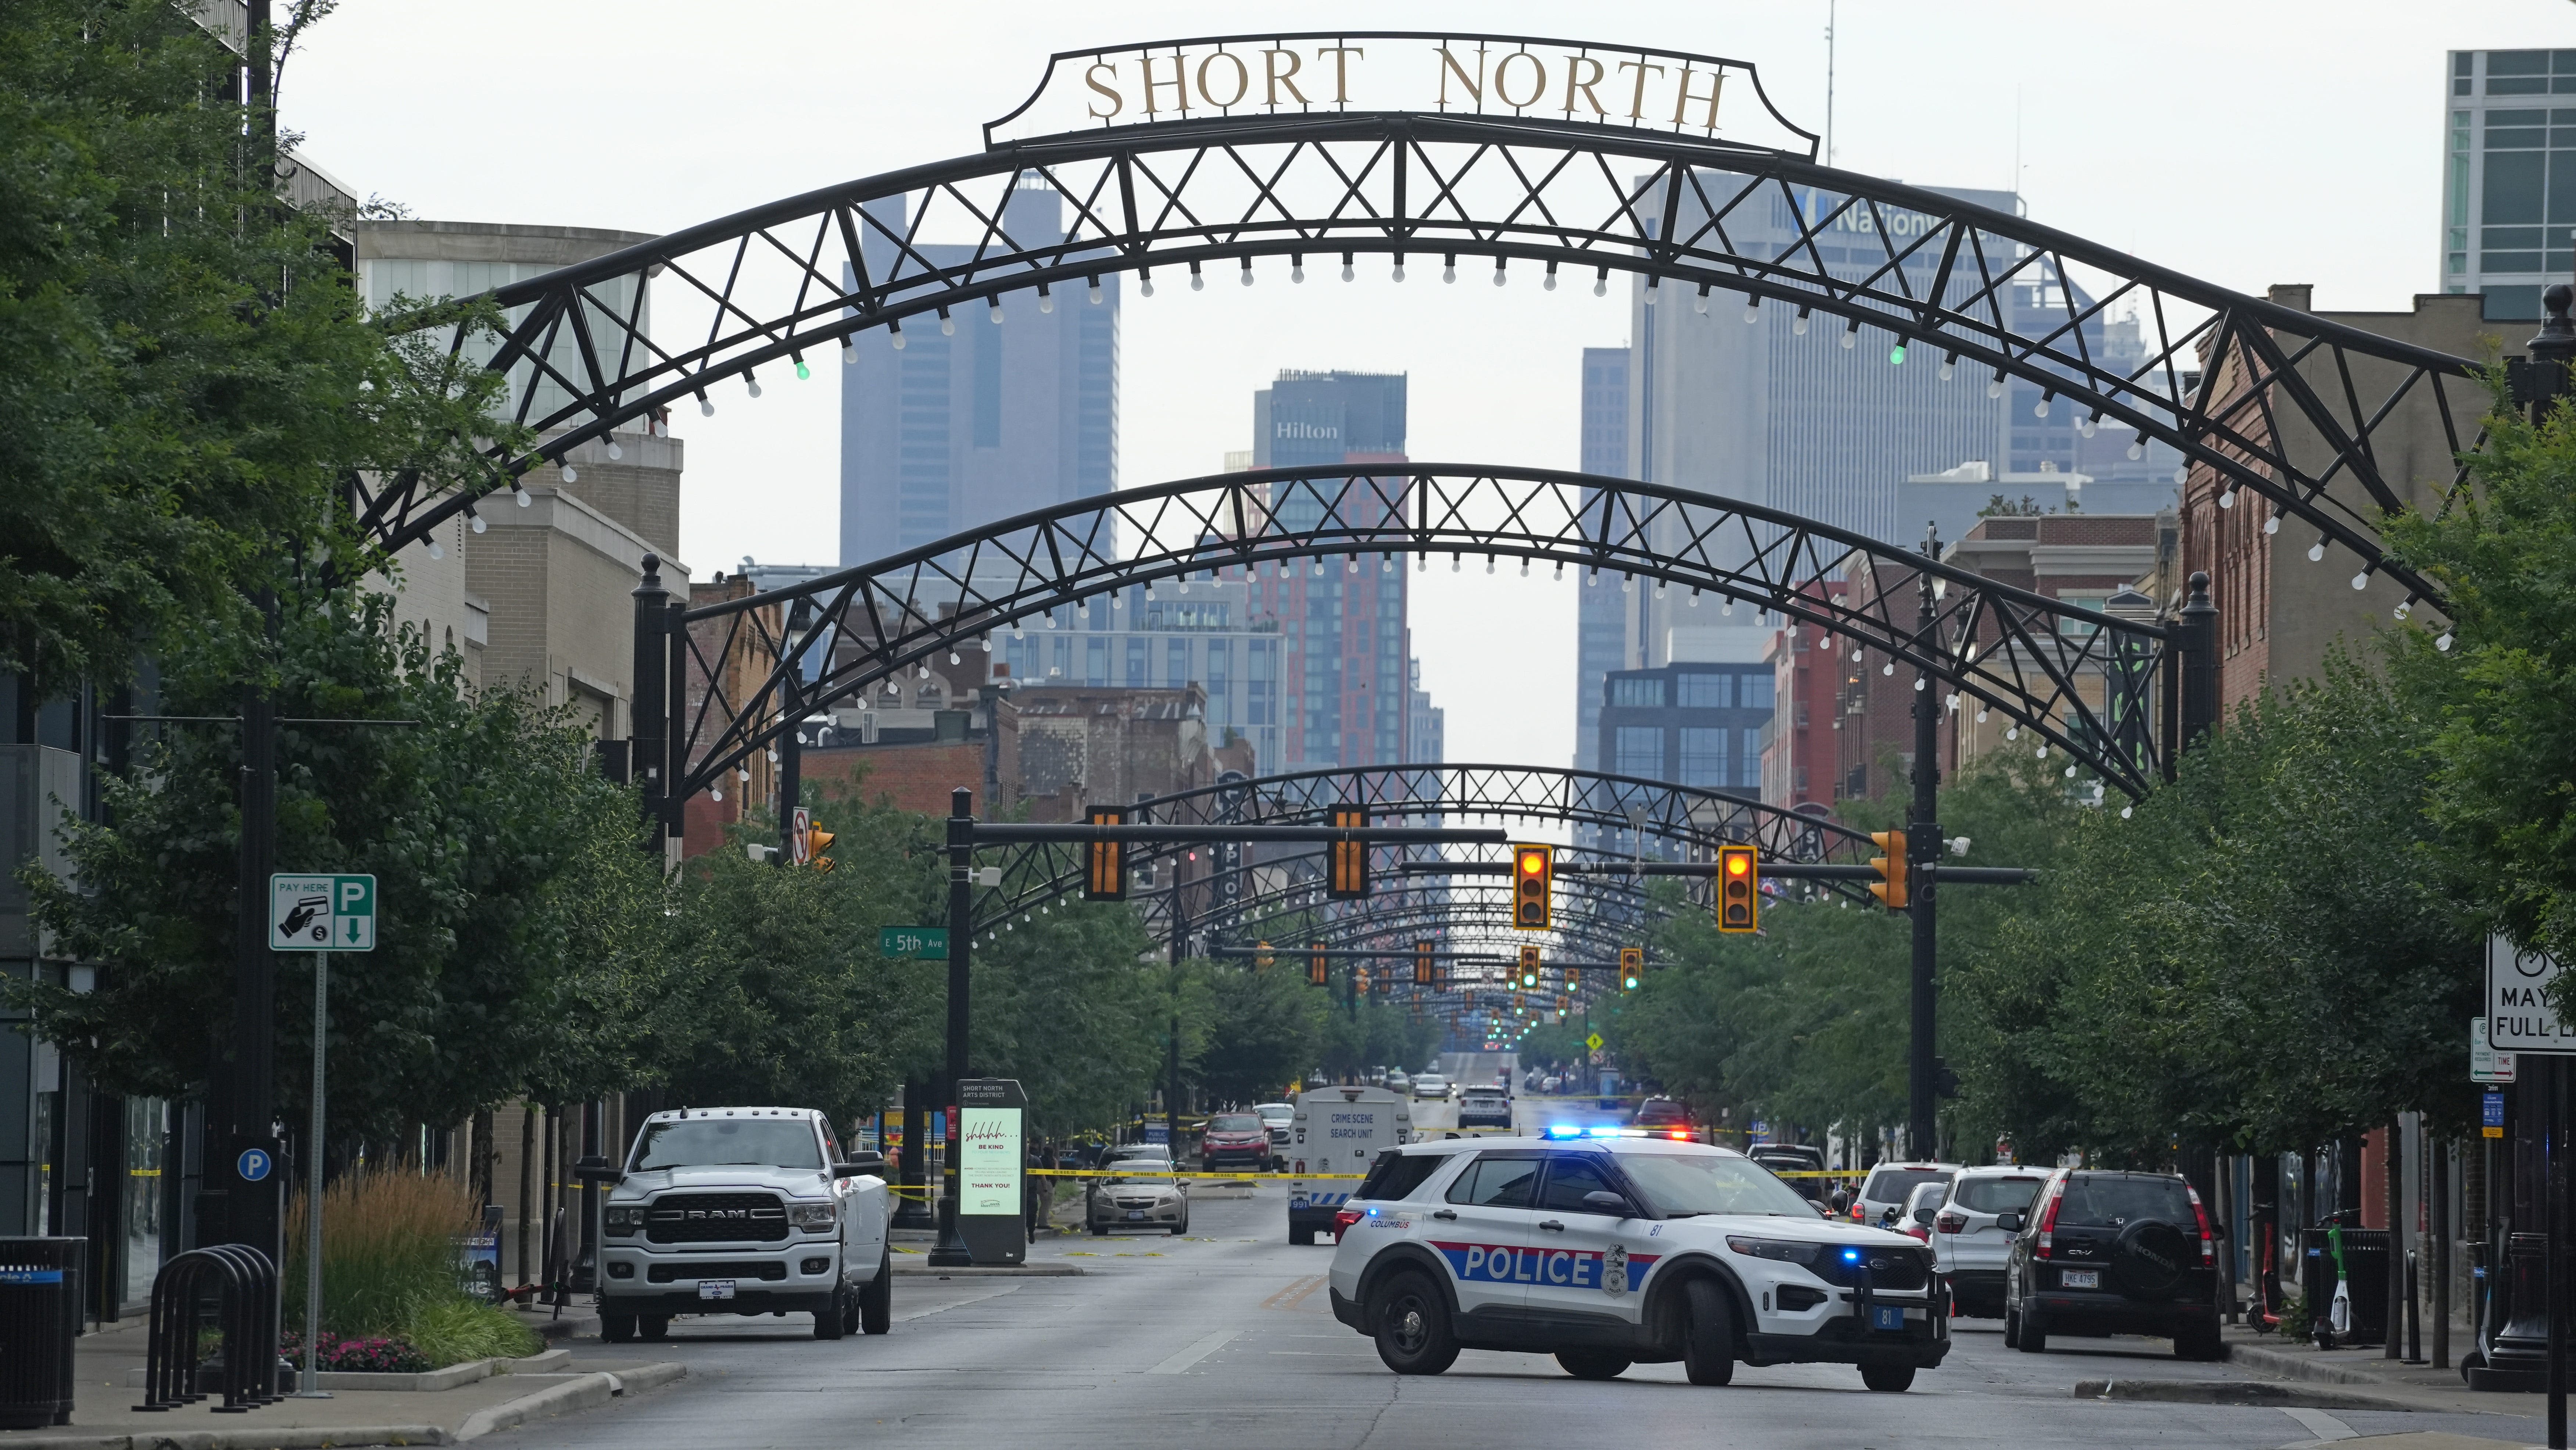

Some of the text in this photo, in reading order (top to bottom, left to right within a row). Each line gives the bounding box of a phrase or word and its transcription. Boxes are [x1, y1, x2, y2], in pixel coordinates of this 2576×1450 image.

[1085, 47, 1731, 130] SHORT NORTH
[1836, 200, 1988, 241] Naionw
[1277, 422, 1337, 439] Hilton
[280, 883, 328, 892] PAY HERE
[341, 882, 365, 911] P
[886, 935, 942, 951] E 5th Ave
[2502, 988, 2552, 1007] MAY
[2497, 1017, 2550, 1036] FULL
[2498, 1057, 2510, 1065] TIME
[1331, 1114, 1373, 1124] CRIME SCENE
[1331, 1129, 1373, 1138] SEARCH UNIT
[248, 1155, 262, 1175] P
[688, 1210, 746, 1219] RAM
[1371, 1220, 1410, 1228] COLUMBUS
[1650, 1225, 1663, 1236] 81
[1464, 1245, 1593, 1285] POLICE
[2134, 1243, 2176, 1271] HONDA
[2065, 1274, 2095, 1283] HKE 4795
[1882, 1309, 1891, 1325] 81
